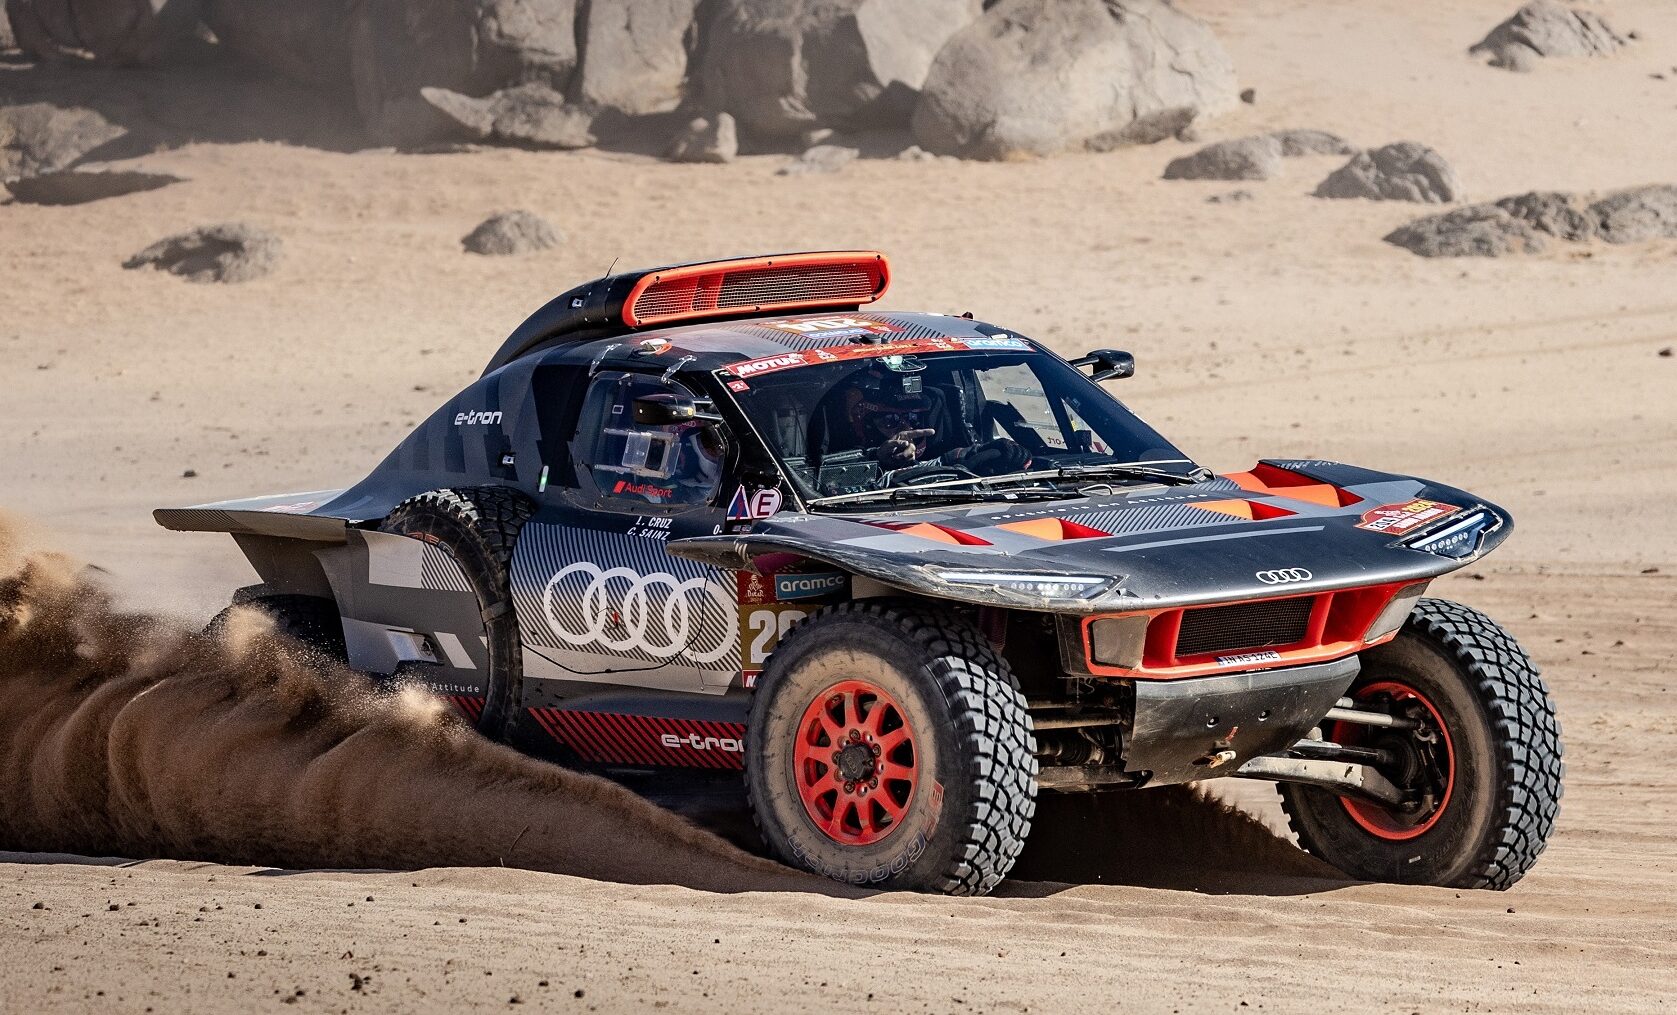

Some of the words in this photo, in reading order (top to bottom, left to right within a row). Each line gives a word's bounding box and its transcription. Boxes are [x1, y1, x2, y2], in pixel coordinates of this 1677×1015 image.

[736, 357, 801, 376] MOTUL
[454, 409, 503, 426] e-tron
[625, 482, 645, 494] Audi
[647, 484, 673, 498] Sport
[757, 494, 775, 516] E
[648, 516, 673, 529] CRUZ
[639, 528, 671, 541] SAINZ
[780, 575, 846, 593] aramco
[432, 682, 480, 693] Attitude
